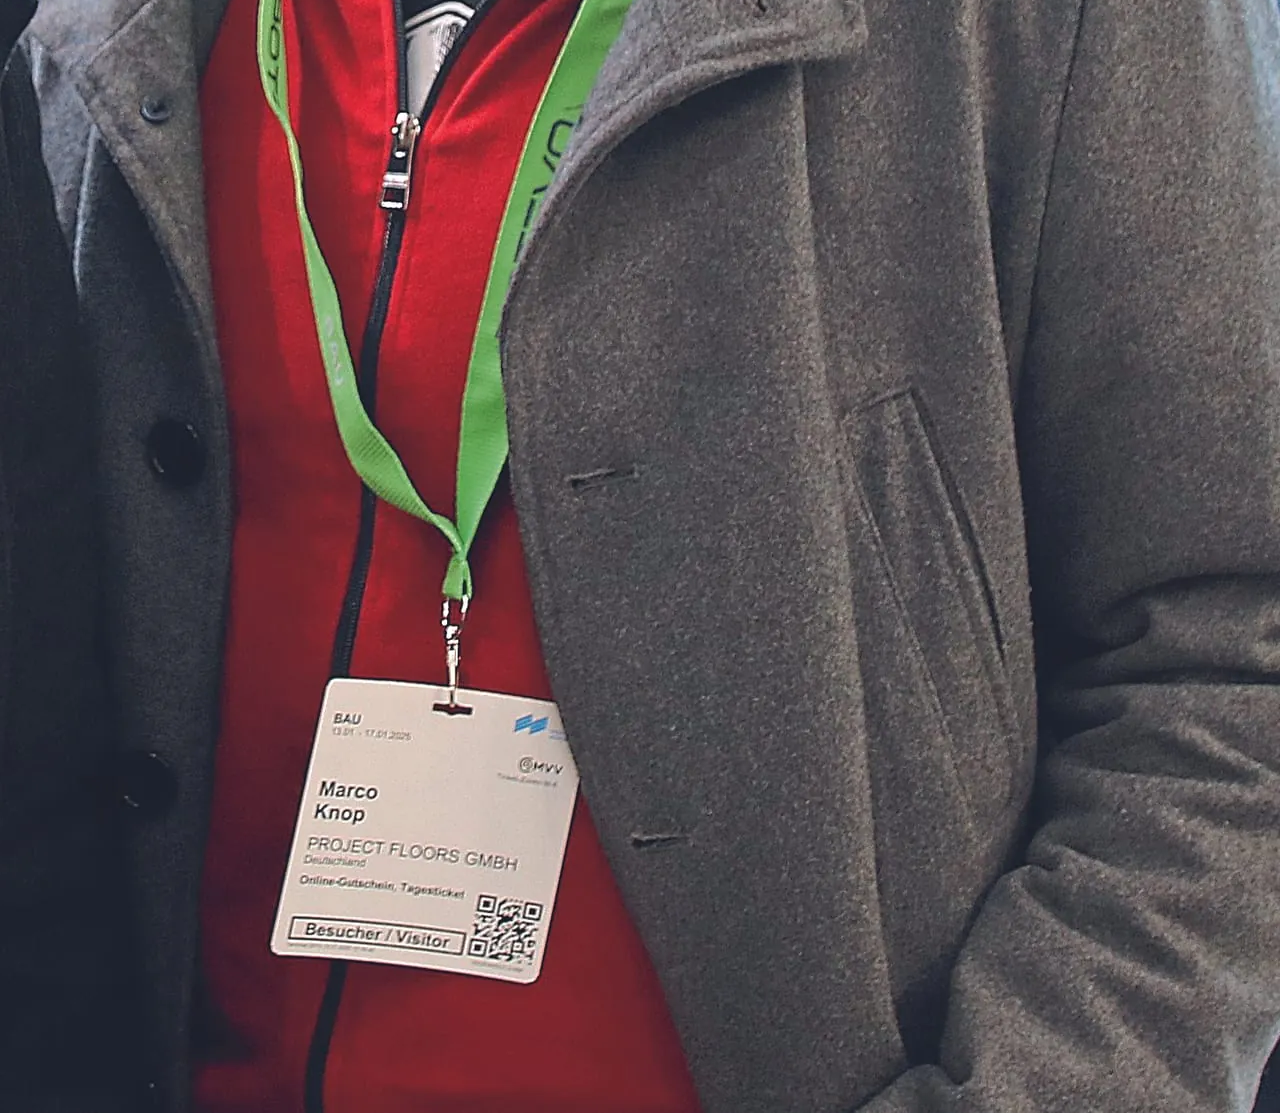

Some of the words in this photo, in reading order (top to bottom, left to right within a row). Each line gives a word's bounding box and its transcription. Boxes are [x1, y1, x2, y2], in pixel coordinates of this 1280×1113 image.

[333, 712, 362, 725] BAU
[318, 780, 378, 800] Marco
[314, 804, 366, 825] Knop
[303, 853, 368, 868] Deutschland
[307, 836, 386, 855] PROJECT
[389, 842, 461, 864] FLOORS
[464, 851, 519, 872] GMBH
[400, 882, 466, 899] Tagesticket
[305, 922, 384, 941] Besucher
[396, 929, 452, 950] Visitor
